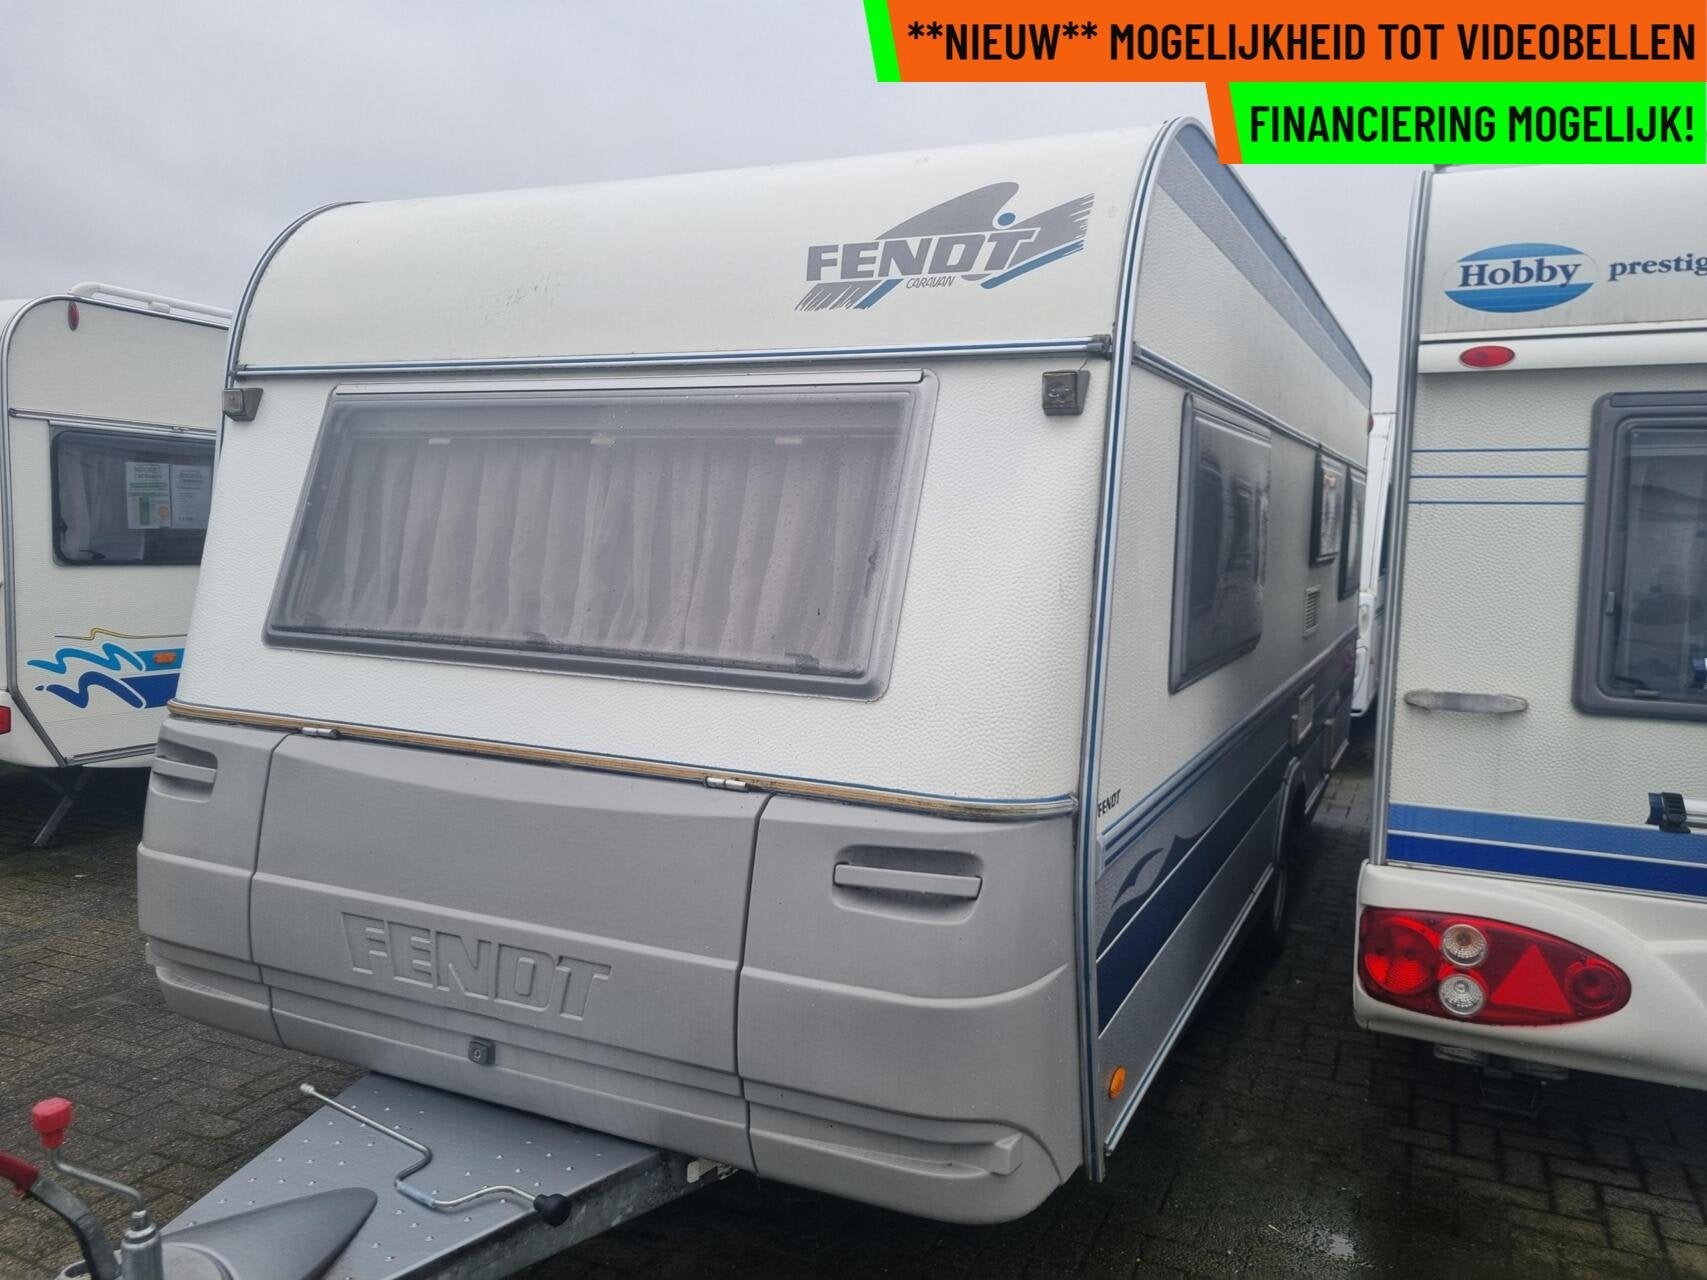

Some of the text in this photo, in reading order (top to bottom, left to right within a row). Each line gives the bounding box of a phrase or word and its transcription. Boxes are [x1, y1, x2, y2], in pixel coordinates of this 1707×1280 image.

[806, 228, 1040, 281] FENDT
[1458, 252, 1707, 288] Hobby prestig
[906, 275, 956, 290] CARAVAN
[1097, 788, 1121, 818] FENDT
[341, 911, 612, 1022] FENDT
